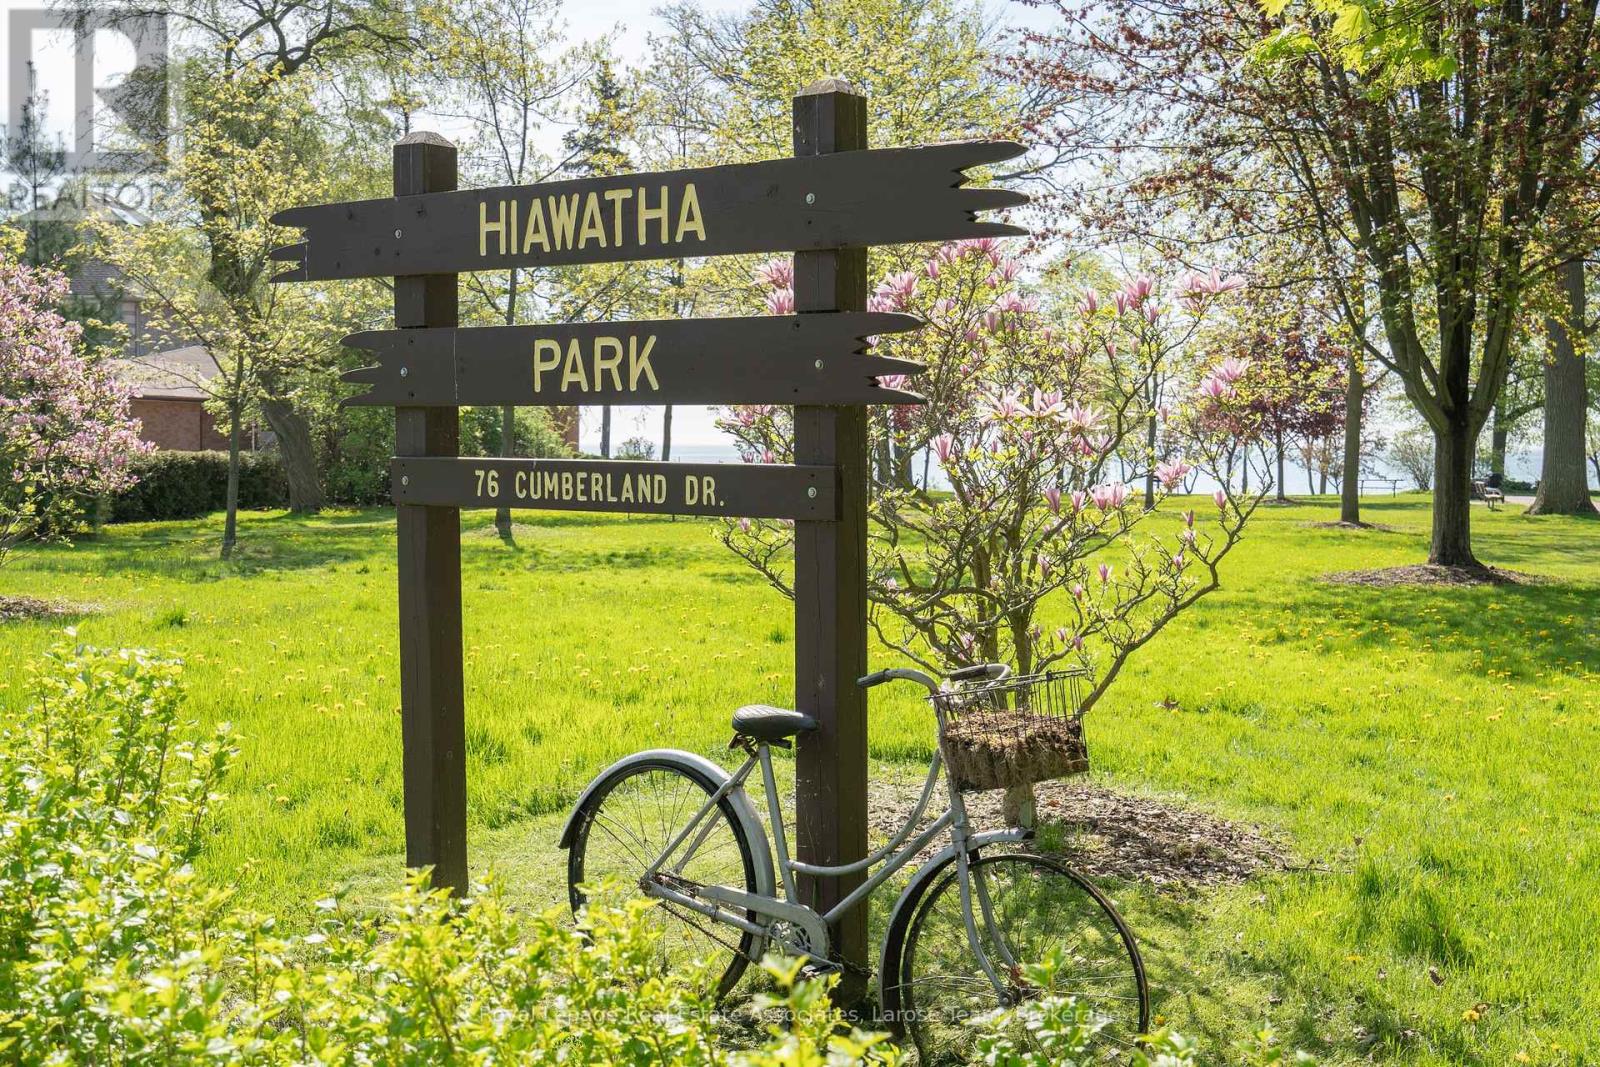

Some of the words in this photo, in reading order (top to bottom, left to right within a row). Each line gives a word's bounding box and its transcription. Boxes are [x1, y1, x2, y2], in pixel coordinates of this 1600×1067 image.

[479, 183, 706, 257] HIAWATHA
[533, 335, 660, 393] PARK
[474, 470, 500, 499] 76
[515, 471, 667, 505] CUMBERLAND
[685, 475, 725, 507] DR.
